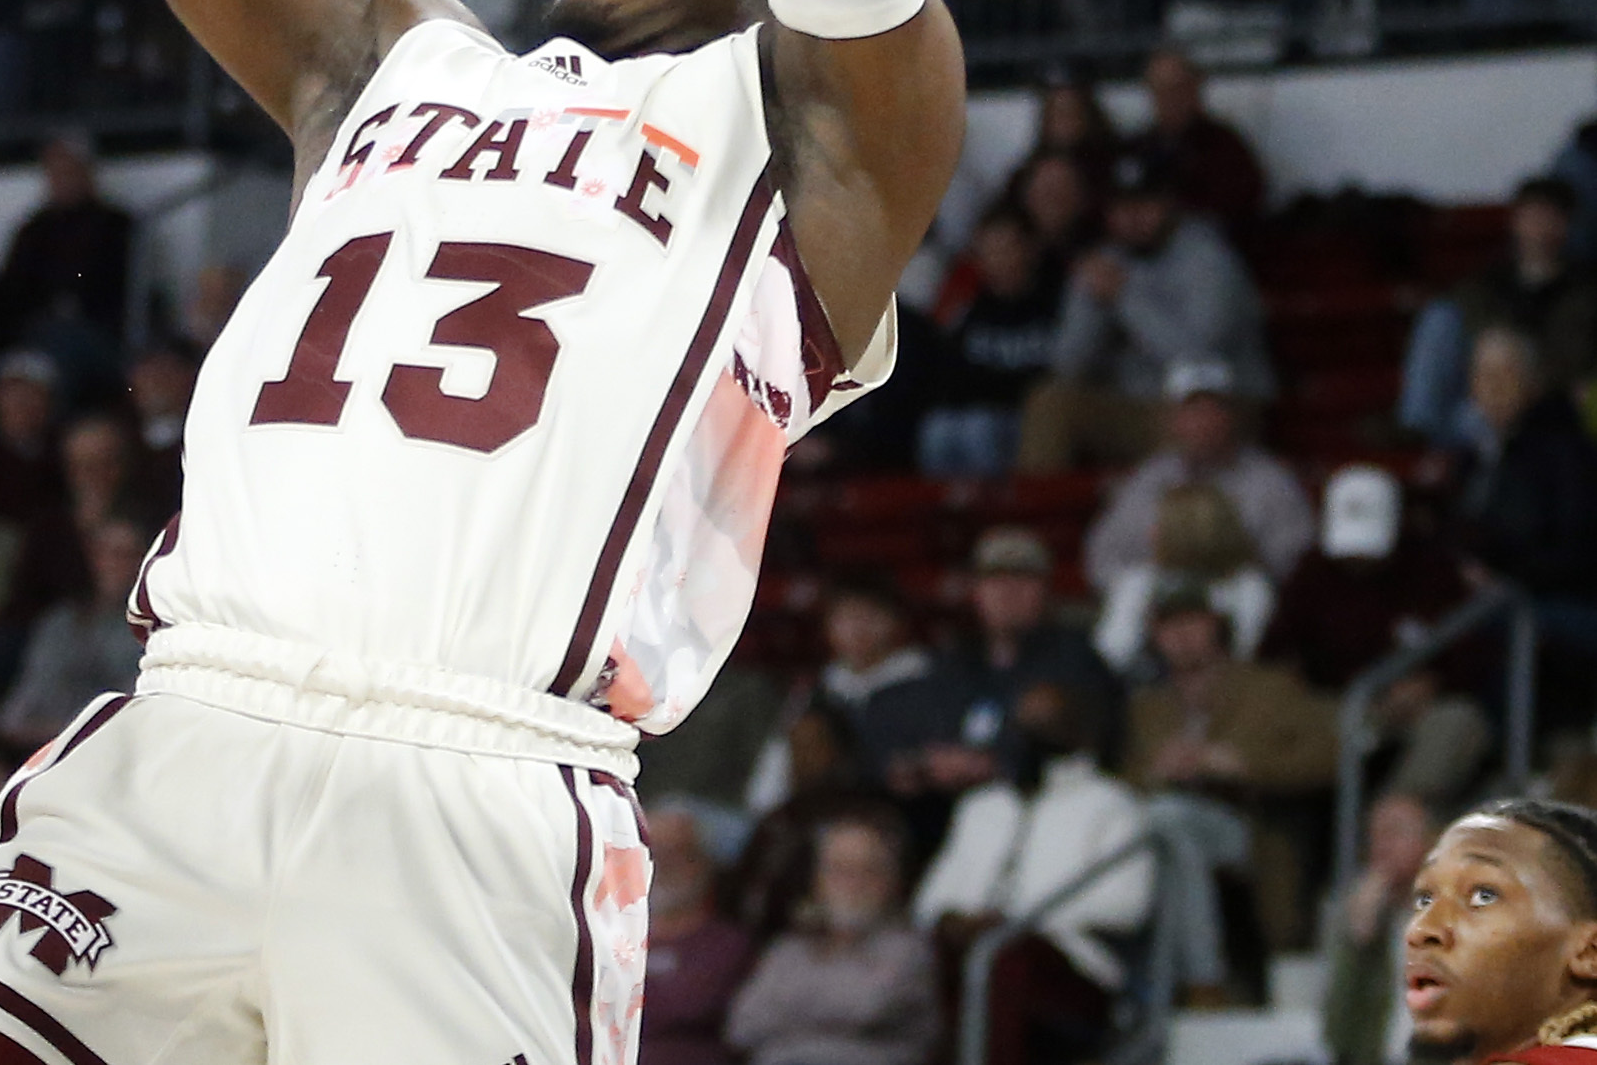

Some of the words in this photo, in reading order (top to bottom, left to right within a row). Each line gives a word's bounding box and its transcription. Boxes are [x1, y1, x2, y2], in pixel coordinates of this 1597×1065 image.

[527, 60, 588, 87] adidas
[324, 102, 701, 250] STATE
[248, 231, 597, 454] 13
